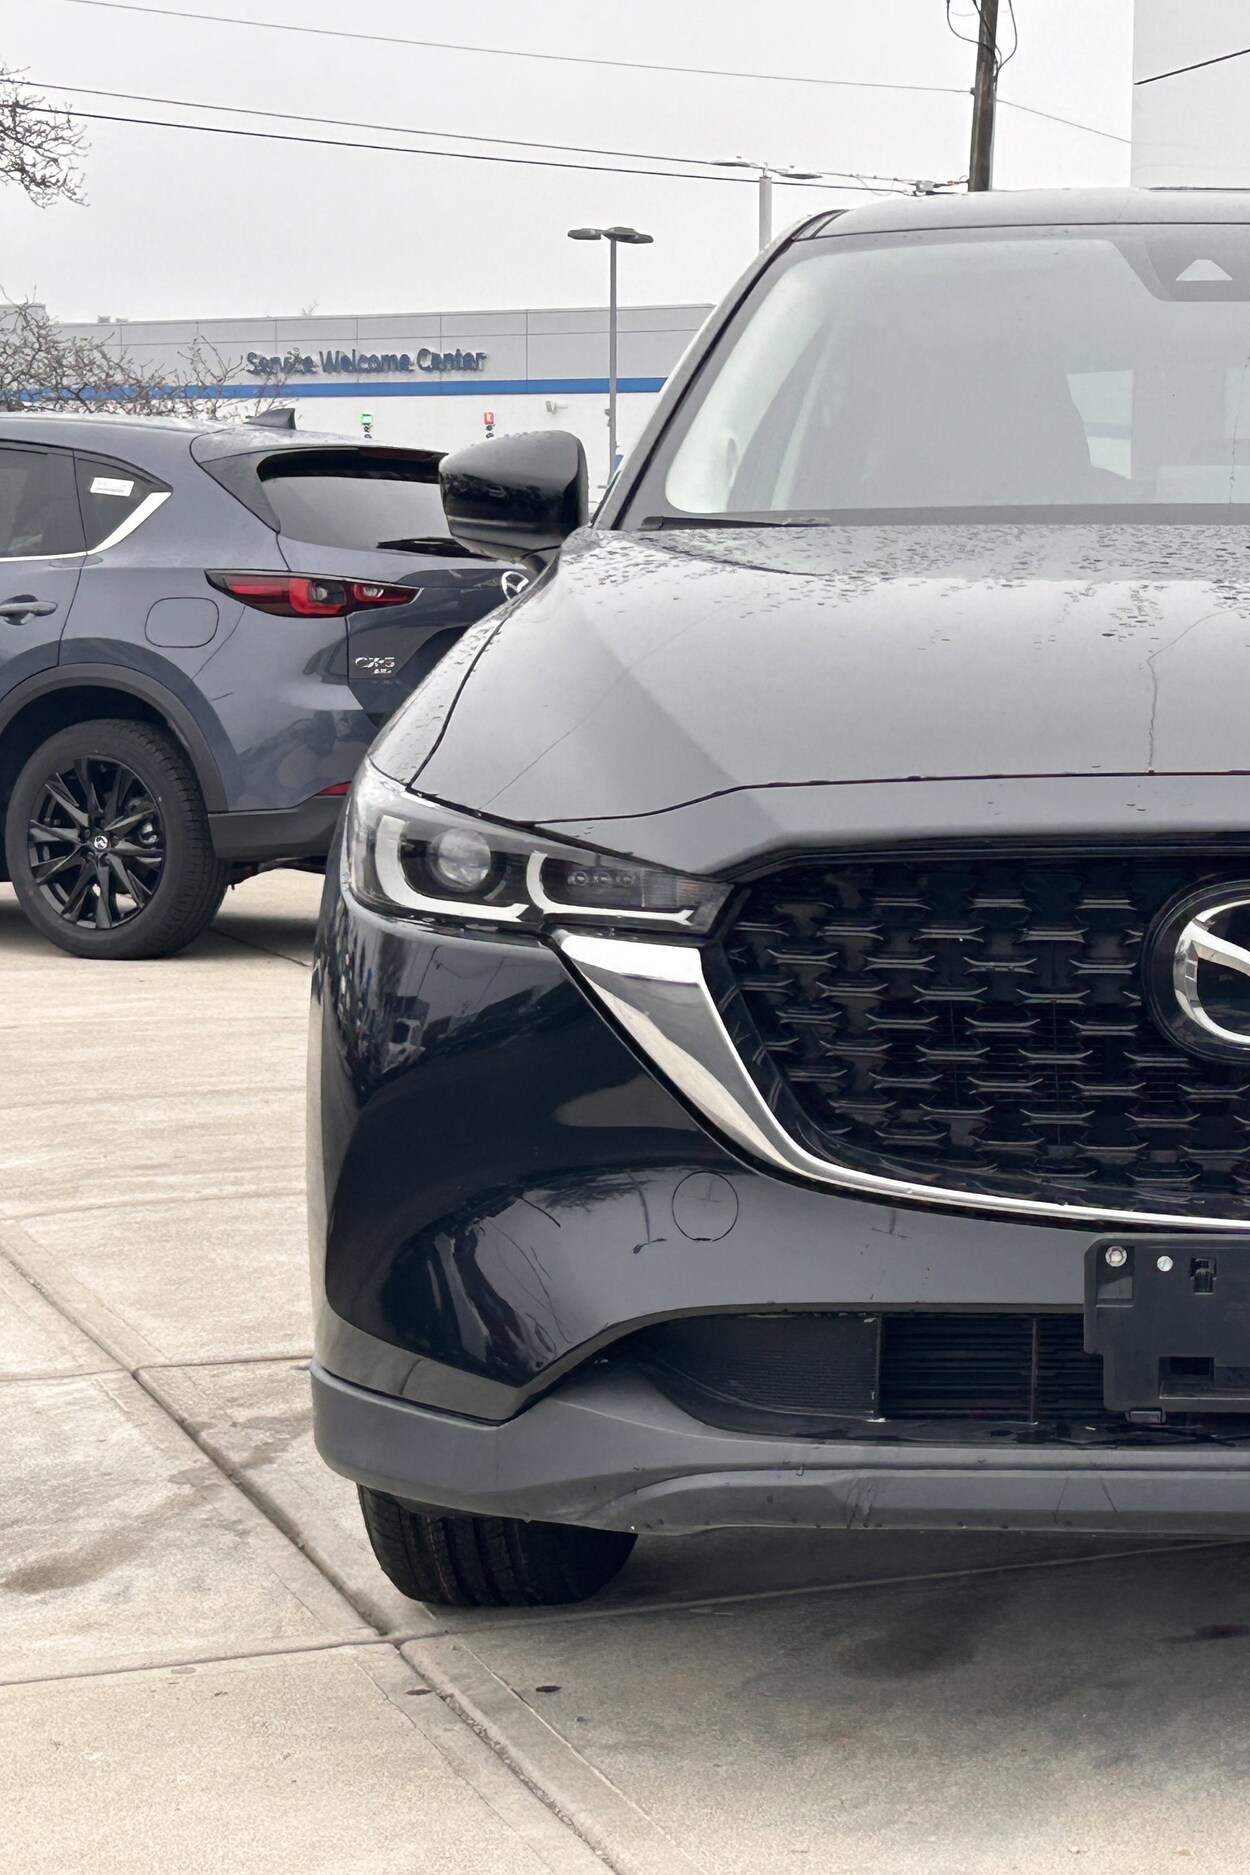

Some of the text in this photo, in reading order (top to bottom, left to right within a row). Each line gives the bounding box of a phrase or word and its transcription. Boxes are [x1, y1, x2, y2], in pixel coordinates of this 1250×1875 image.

[319, 349, 415, 374] Welcome
[416, 347, 488, 372] Center
[354, 656, 396, 669] CX-5
